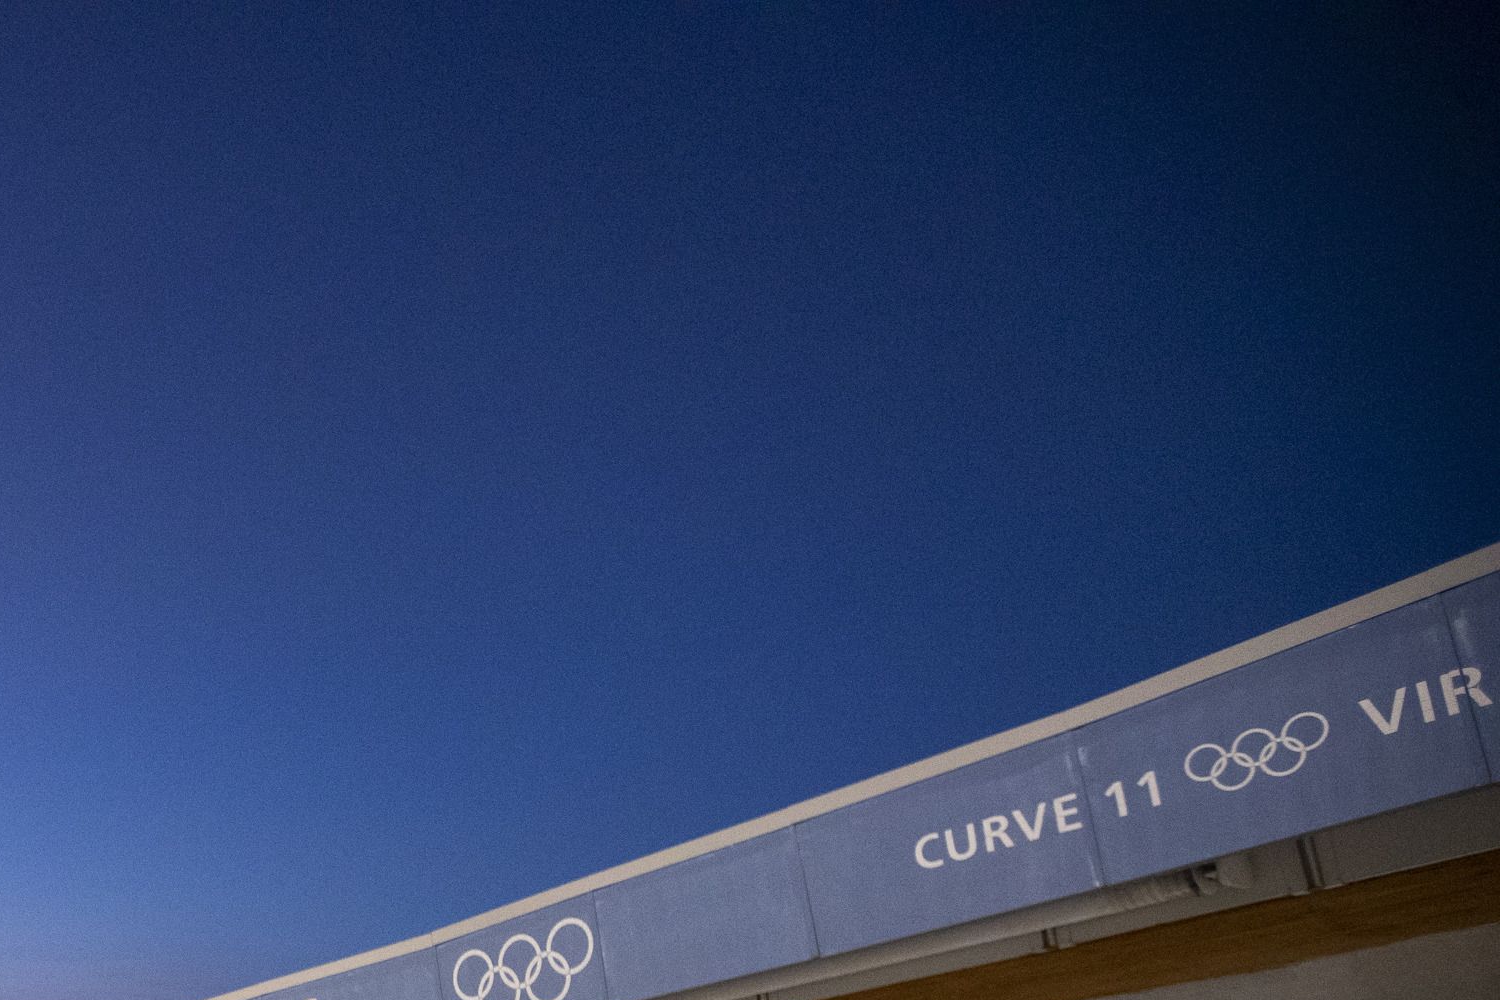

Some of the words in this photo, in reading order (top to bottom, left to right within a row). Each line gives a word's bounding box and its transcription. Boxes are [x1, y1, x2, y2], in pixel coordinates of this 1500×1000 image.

[914, 792, 1084, 869] CURVE
[1104, 770, 1162, 818] 11
[1357, 667, 1493, 735] VIR
